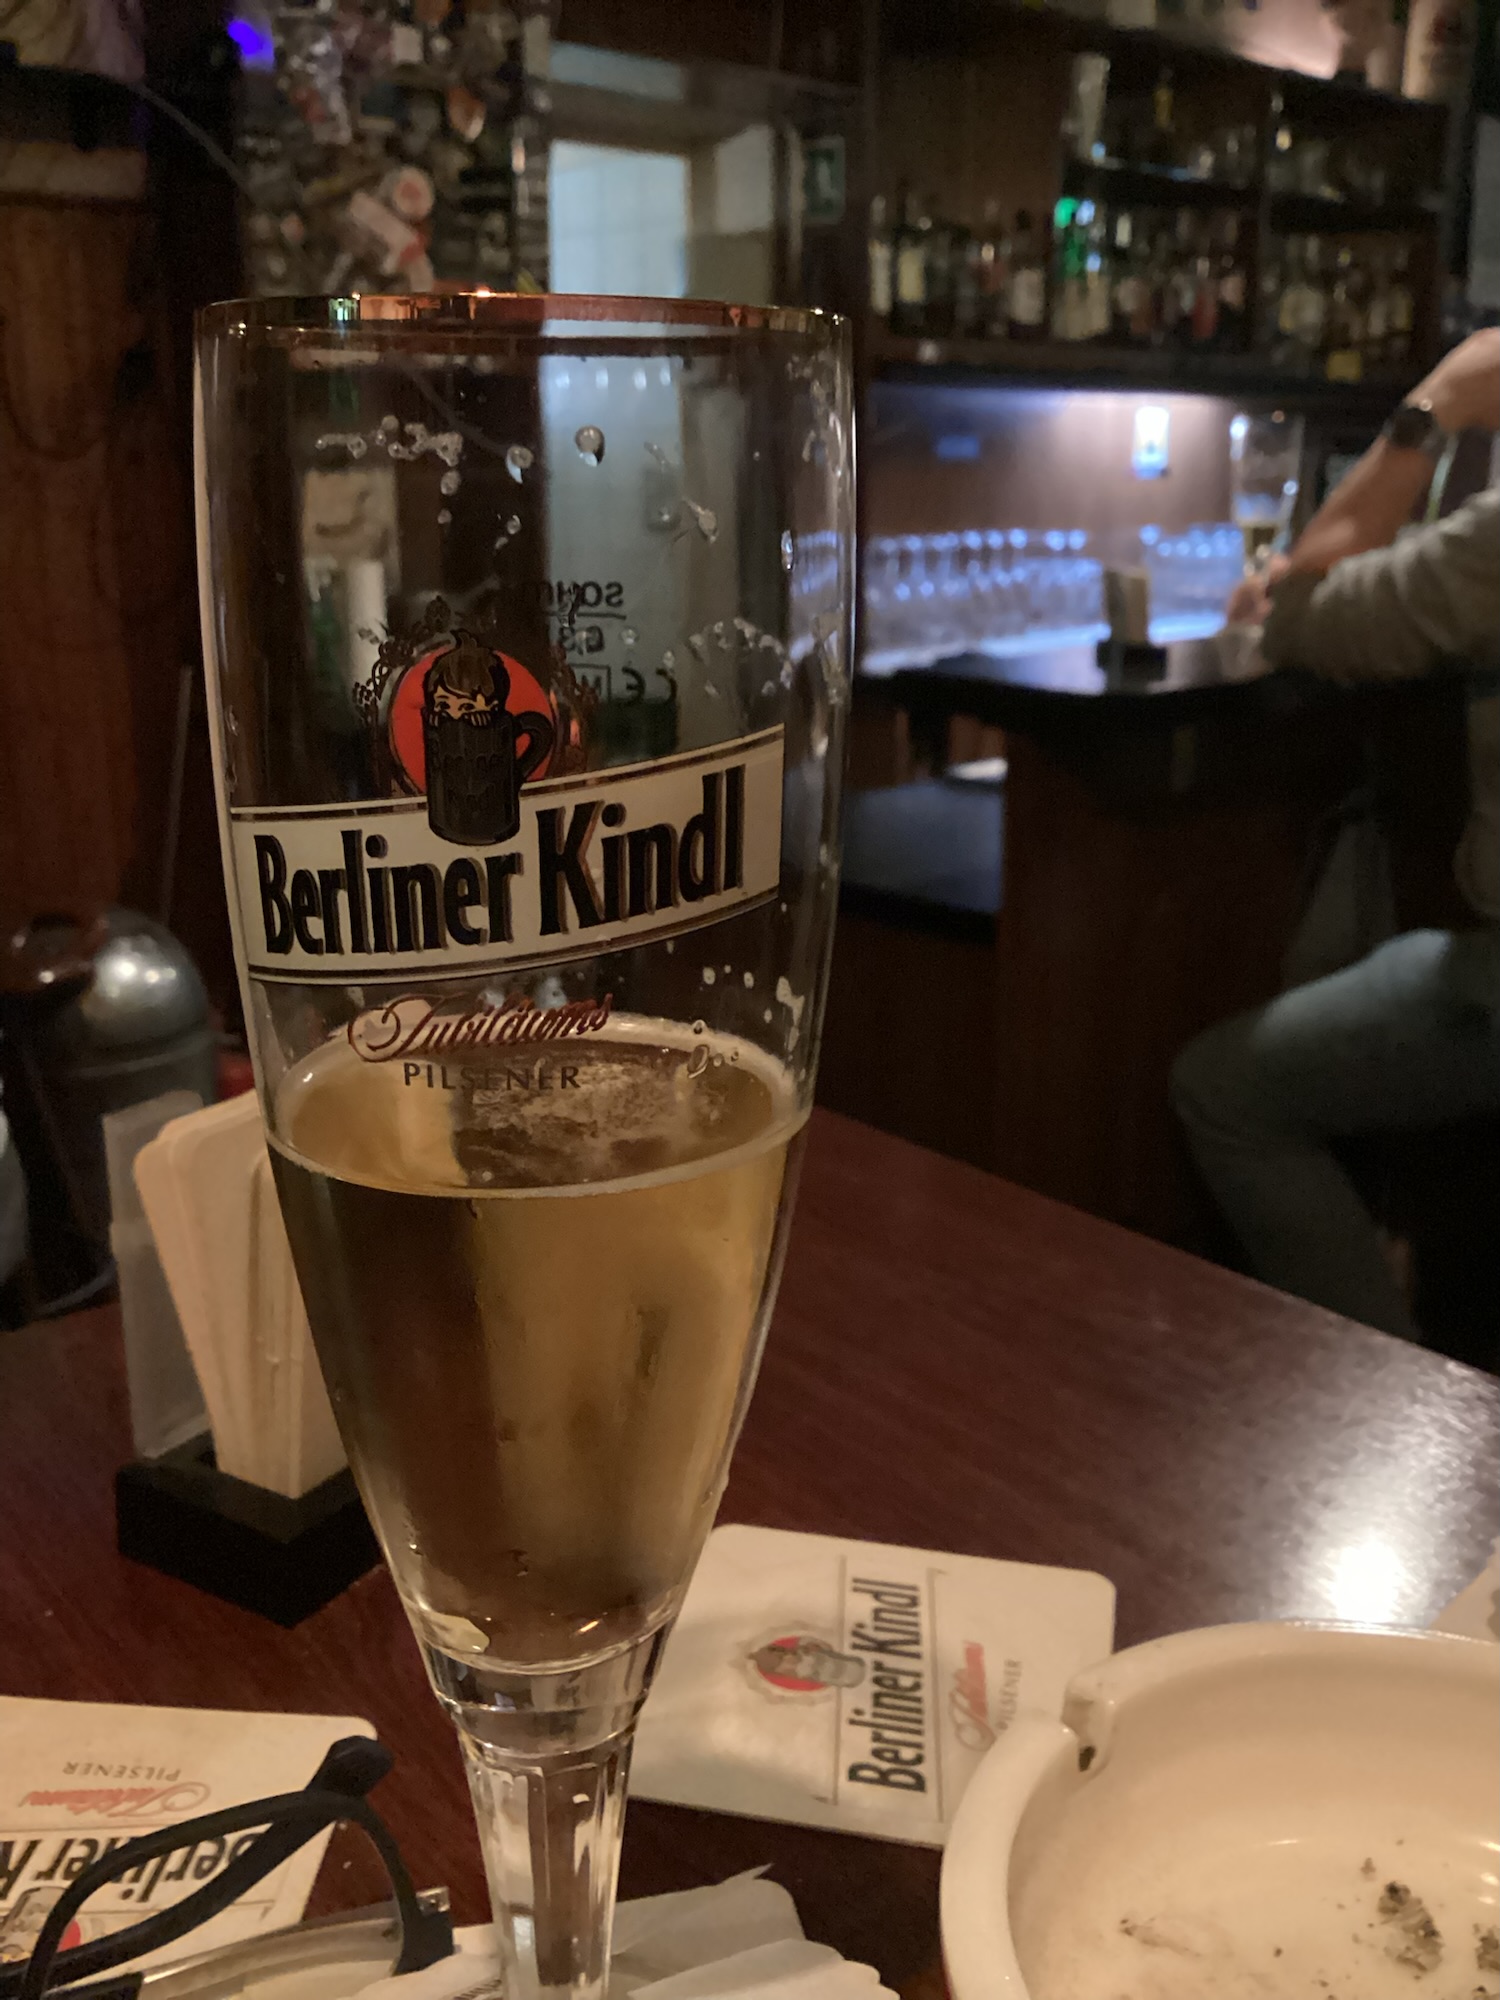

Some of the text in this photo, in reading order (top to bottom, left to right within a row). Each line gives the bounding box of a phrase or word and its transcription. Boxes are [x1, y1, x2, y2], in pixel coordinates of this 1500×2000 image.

[254, 764, 747, 955] Berliner Kindl
[403, 1062, 581, 1090] PILSENER
[848, 1577, 927, 1793] Berliner Kindl
[62, 1760, 182, 1783] PILSENER
